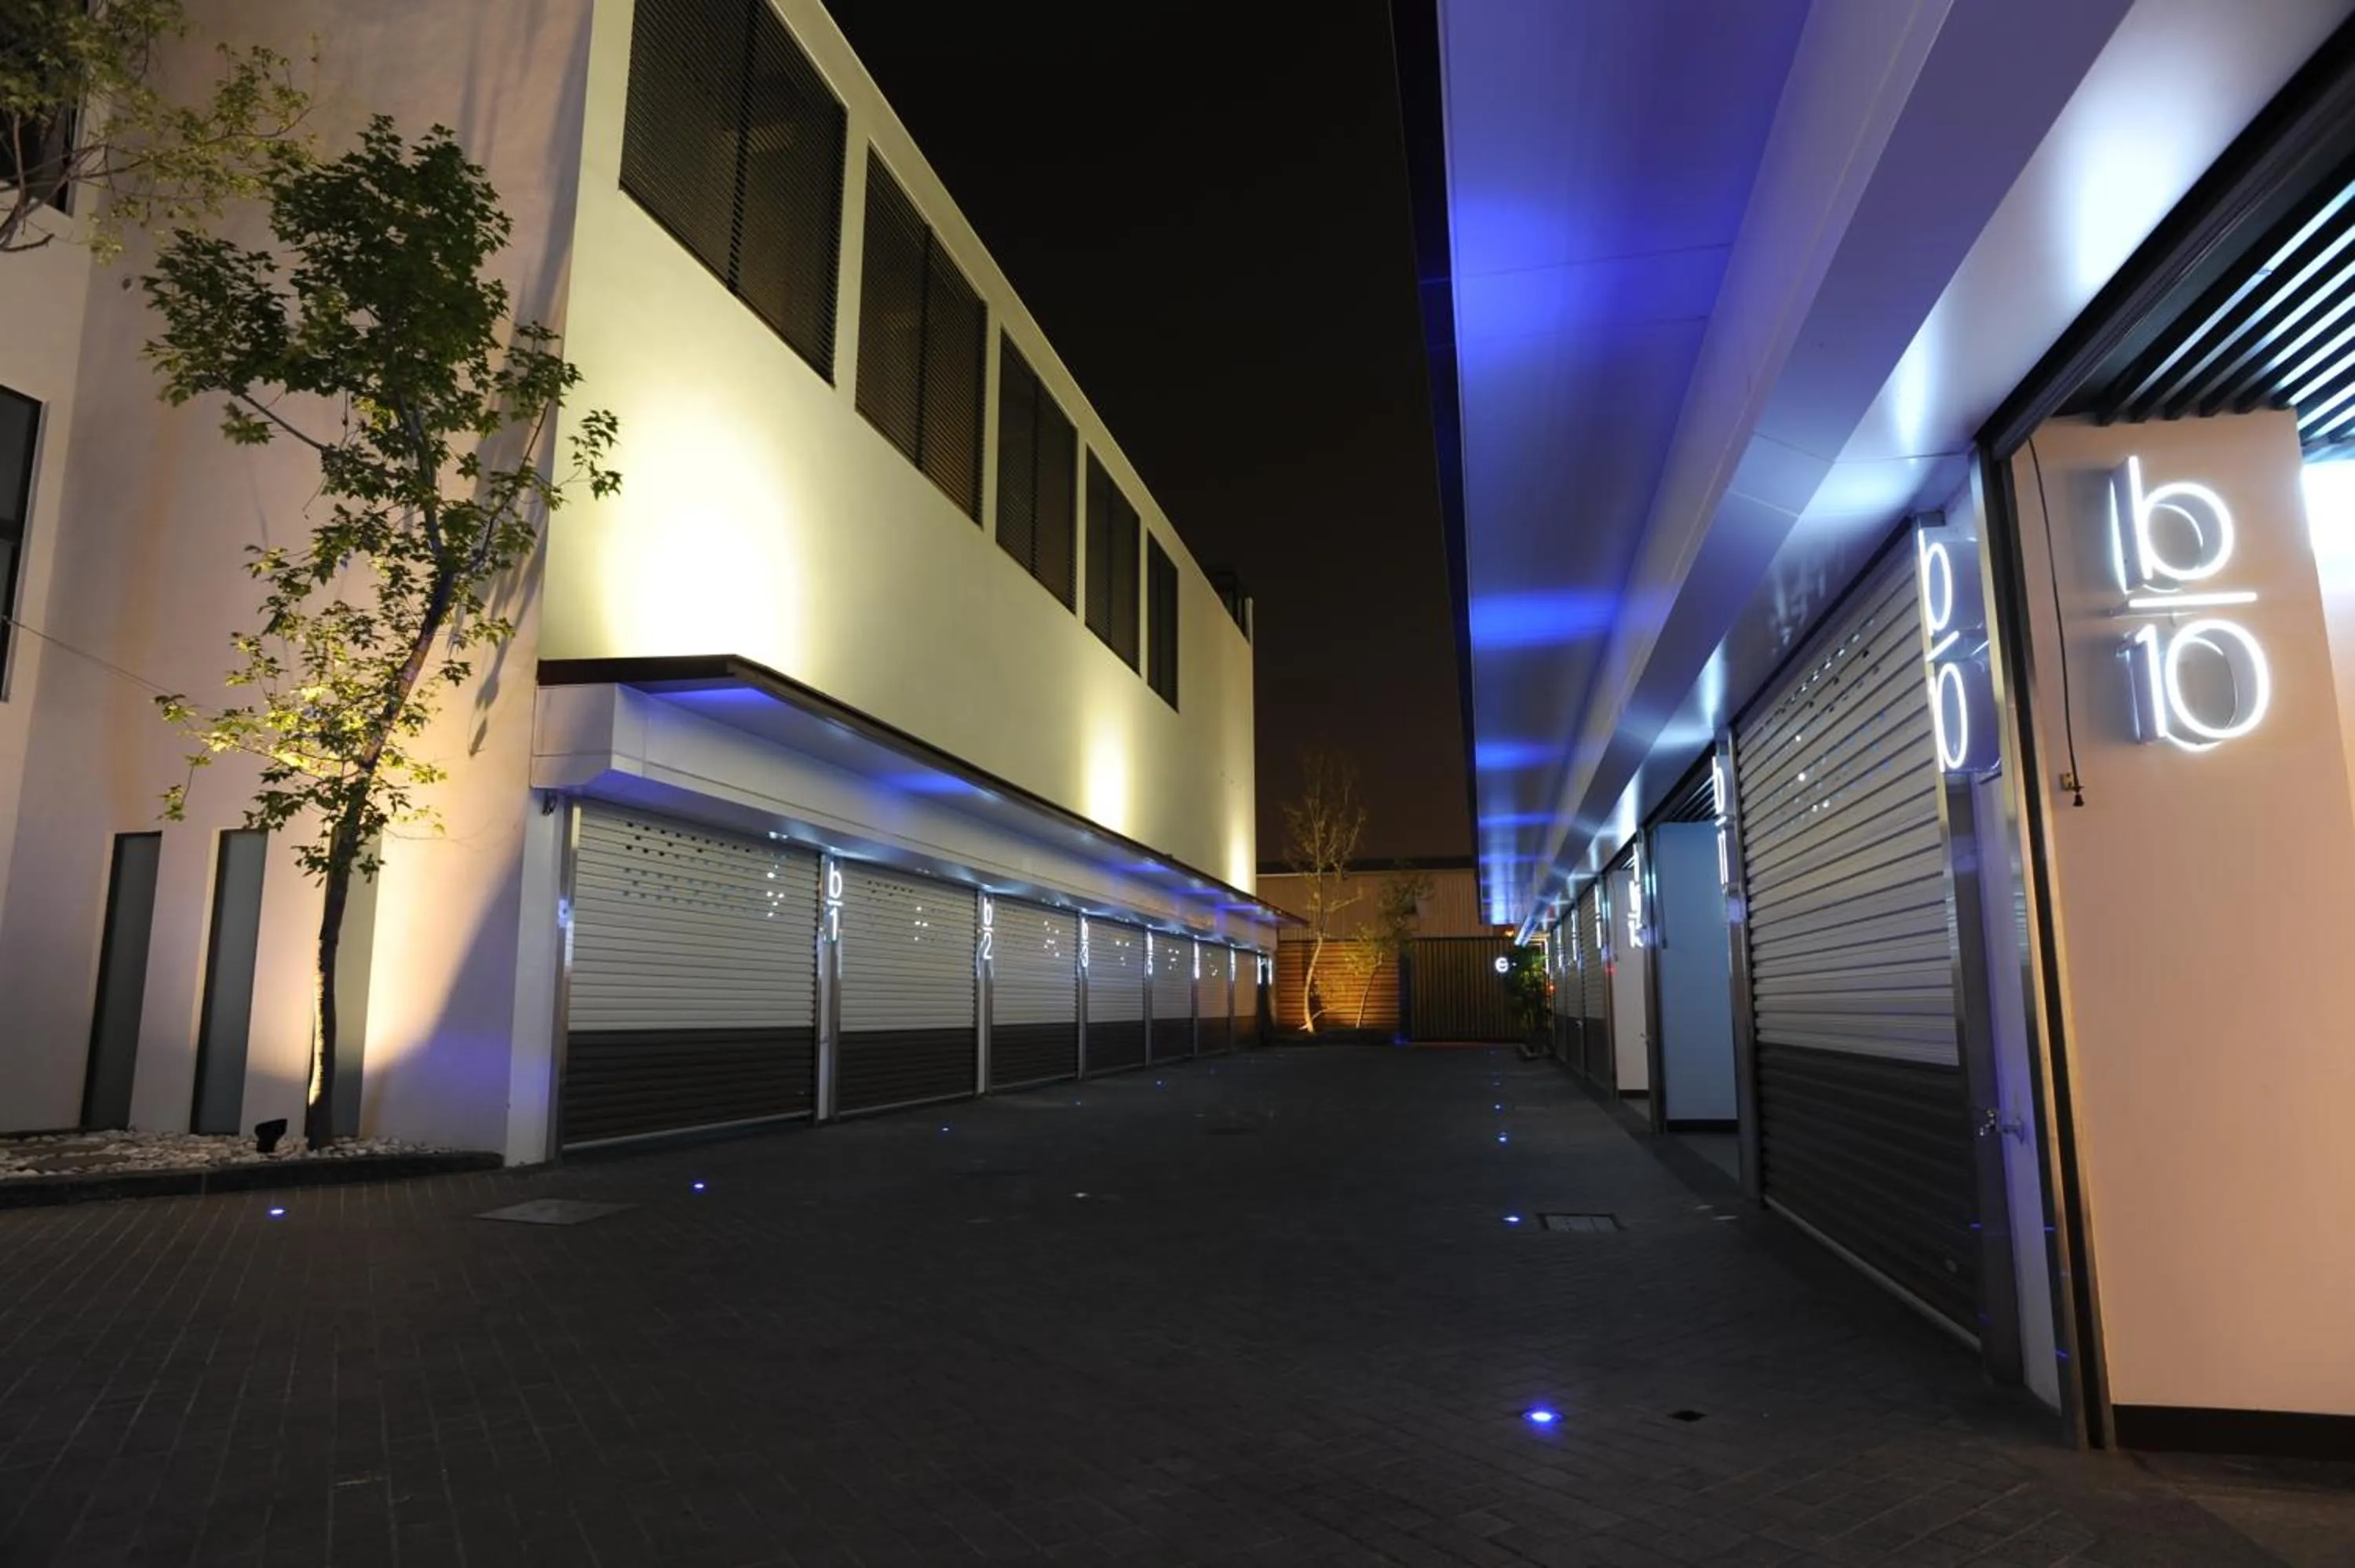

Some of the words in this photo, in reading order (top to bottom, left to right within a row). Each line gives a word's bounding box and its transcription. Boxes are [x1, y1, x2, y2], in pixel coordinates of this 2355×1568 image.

[2127, 455, 2234, 581] b
[1918, 528, 1953, 637] b
[2135, 618, 2271, 739] 10
[828, 861, 843, 899] b
[828, 906, 839, 942] 1
[983, 897, 993, 927] b
[982, 931, 993, 960] 2
